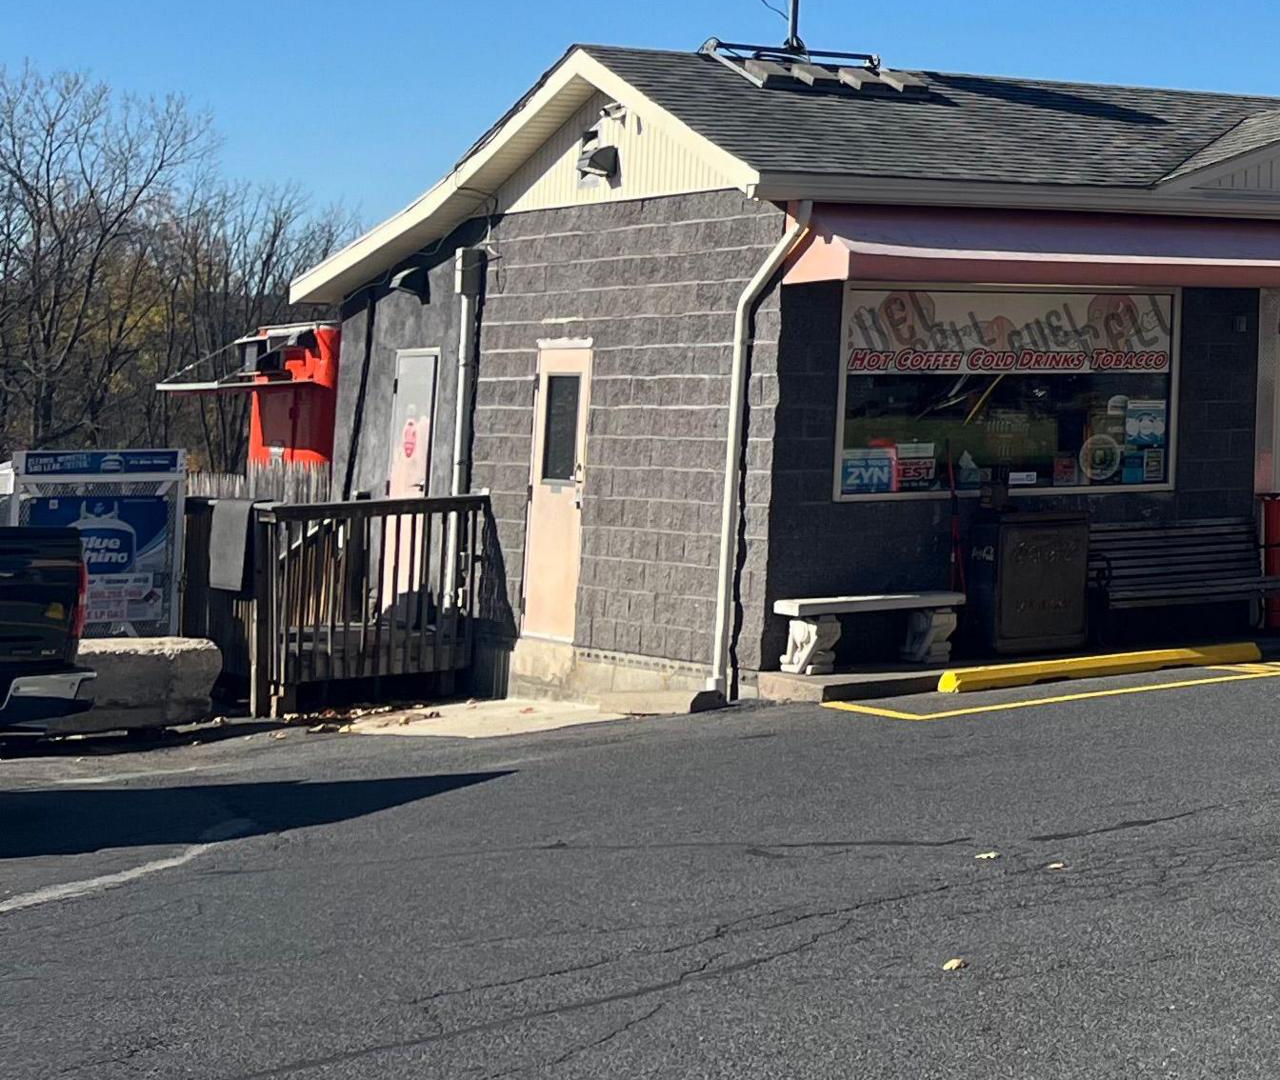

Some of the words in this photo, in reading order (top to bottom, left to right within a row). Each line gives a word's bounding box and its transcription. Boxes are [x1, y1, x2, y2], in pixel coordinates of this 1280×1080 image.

[848, 349, 895, 371] HOT
[896, 348, 963, 371] COFFEE
[968, 349, 1016, 370] COLD
[1016, 349, 1086, 370] DRINKS
[1090, 349, 1168, 370] TOBACCO
[847, 466, 890, 484] ZYN
